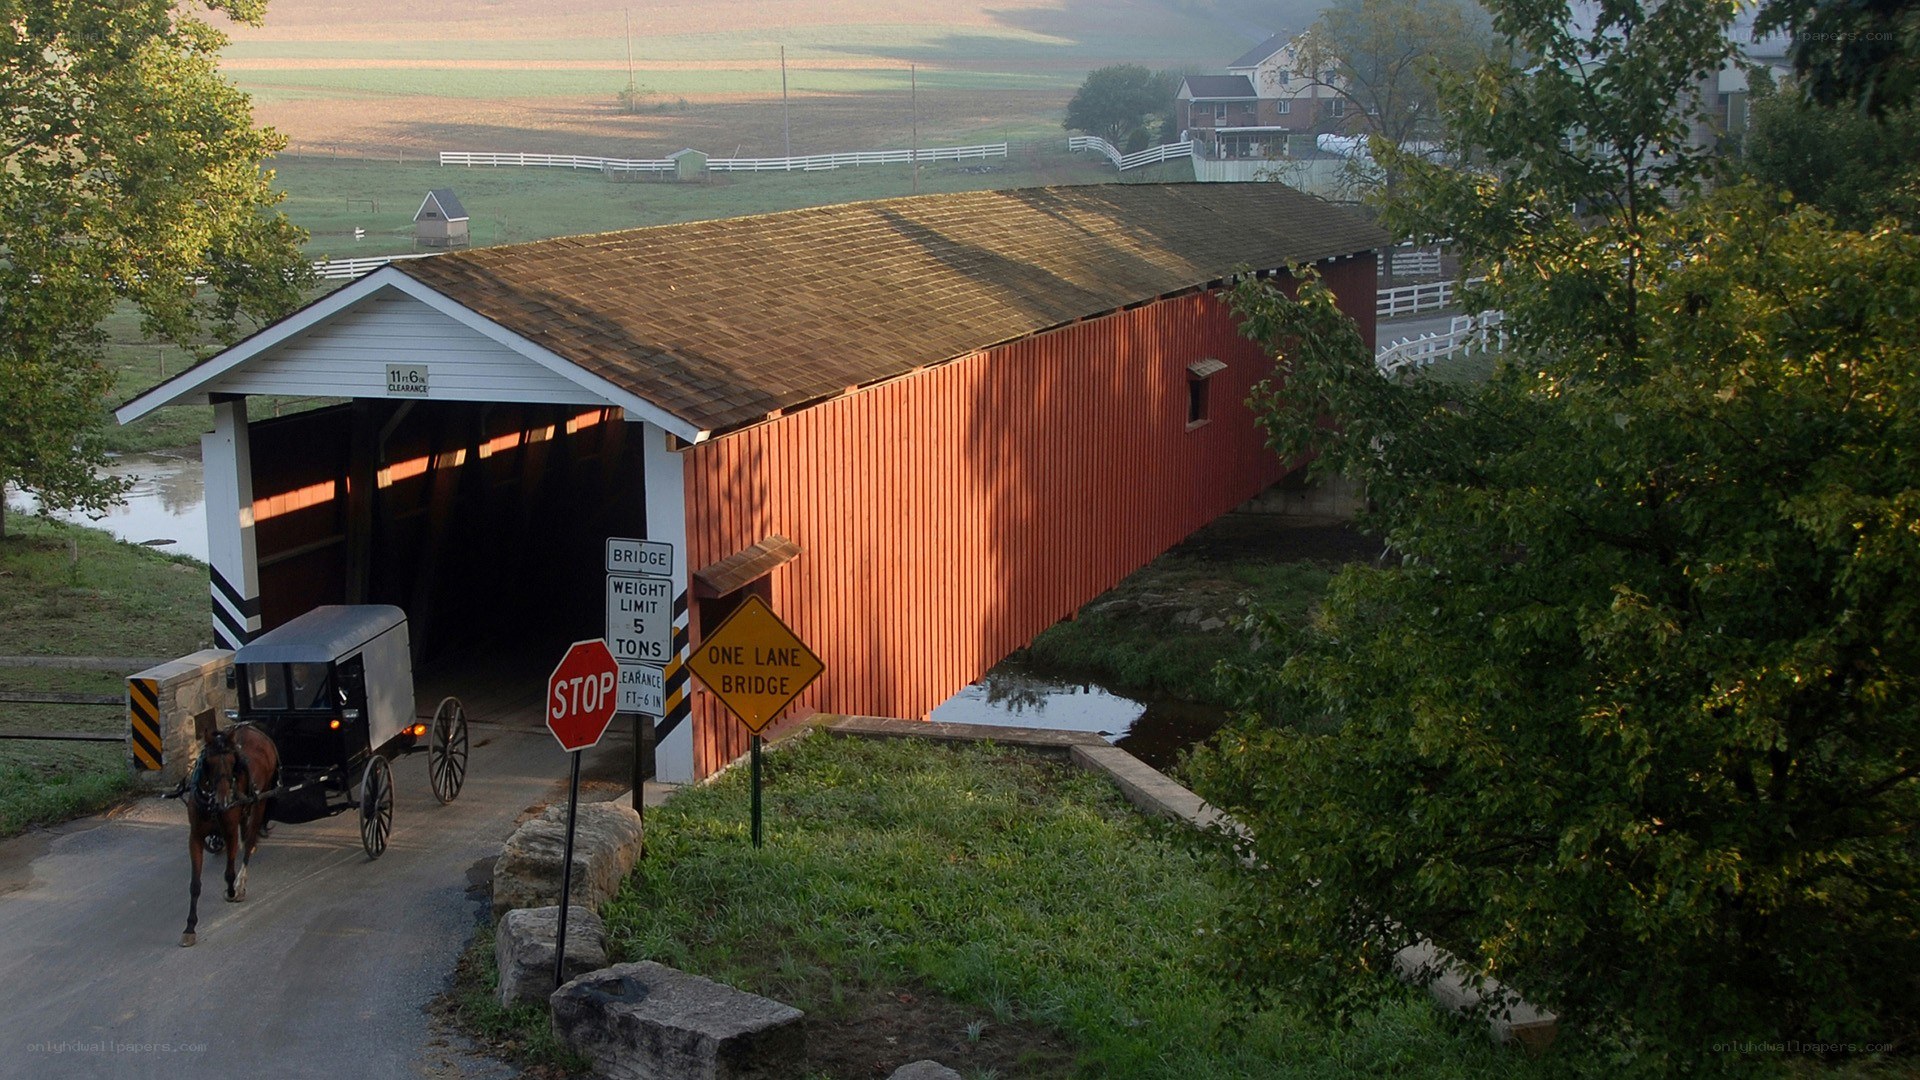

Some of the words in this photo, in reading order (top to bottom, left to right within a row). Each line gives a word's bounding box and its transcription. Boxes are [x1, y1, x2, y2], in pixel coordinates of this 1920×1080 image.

[388, 384, 427, 393] CLEARANCE
[613, 549, 666, 566] BRIDGE
[613, 581, 666, 597] WEIGHT
[620, 599, 658, 614] LIMIT
[633, 618, 645, 634] 5
[616, 639, 661, 657] TONS
[709, 646, 744, 666] ONE
[755, 648, 800, 667] LANE
[618, 670, 661, 689] EARANCE
[722, 675, 790, 696] BRIDGE
[552, 671, 615, 720] STOP
[652, 695, 661, 708] IN
